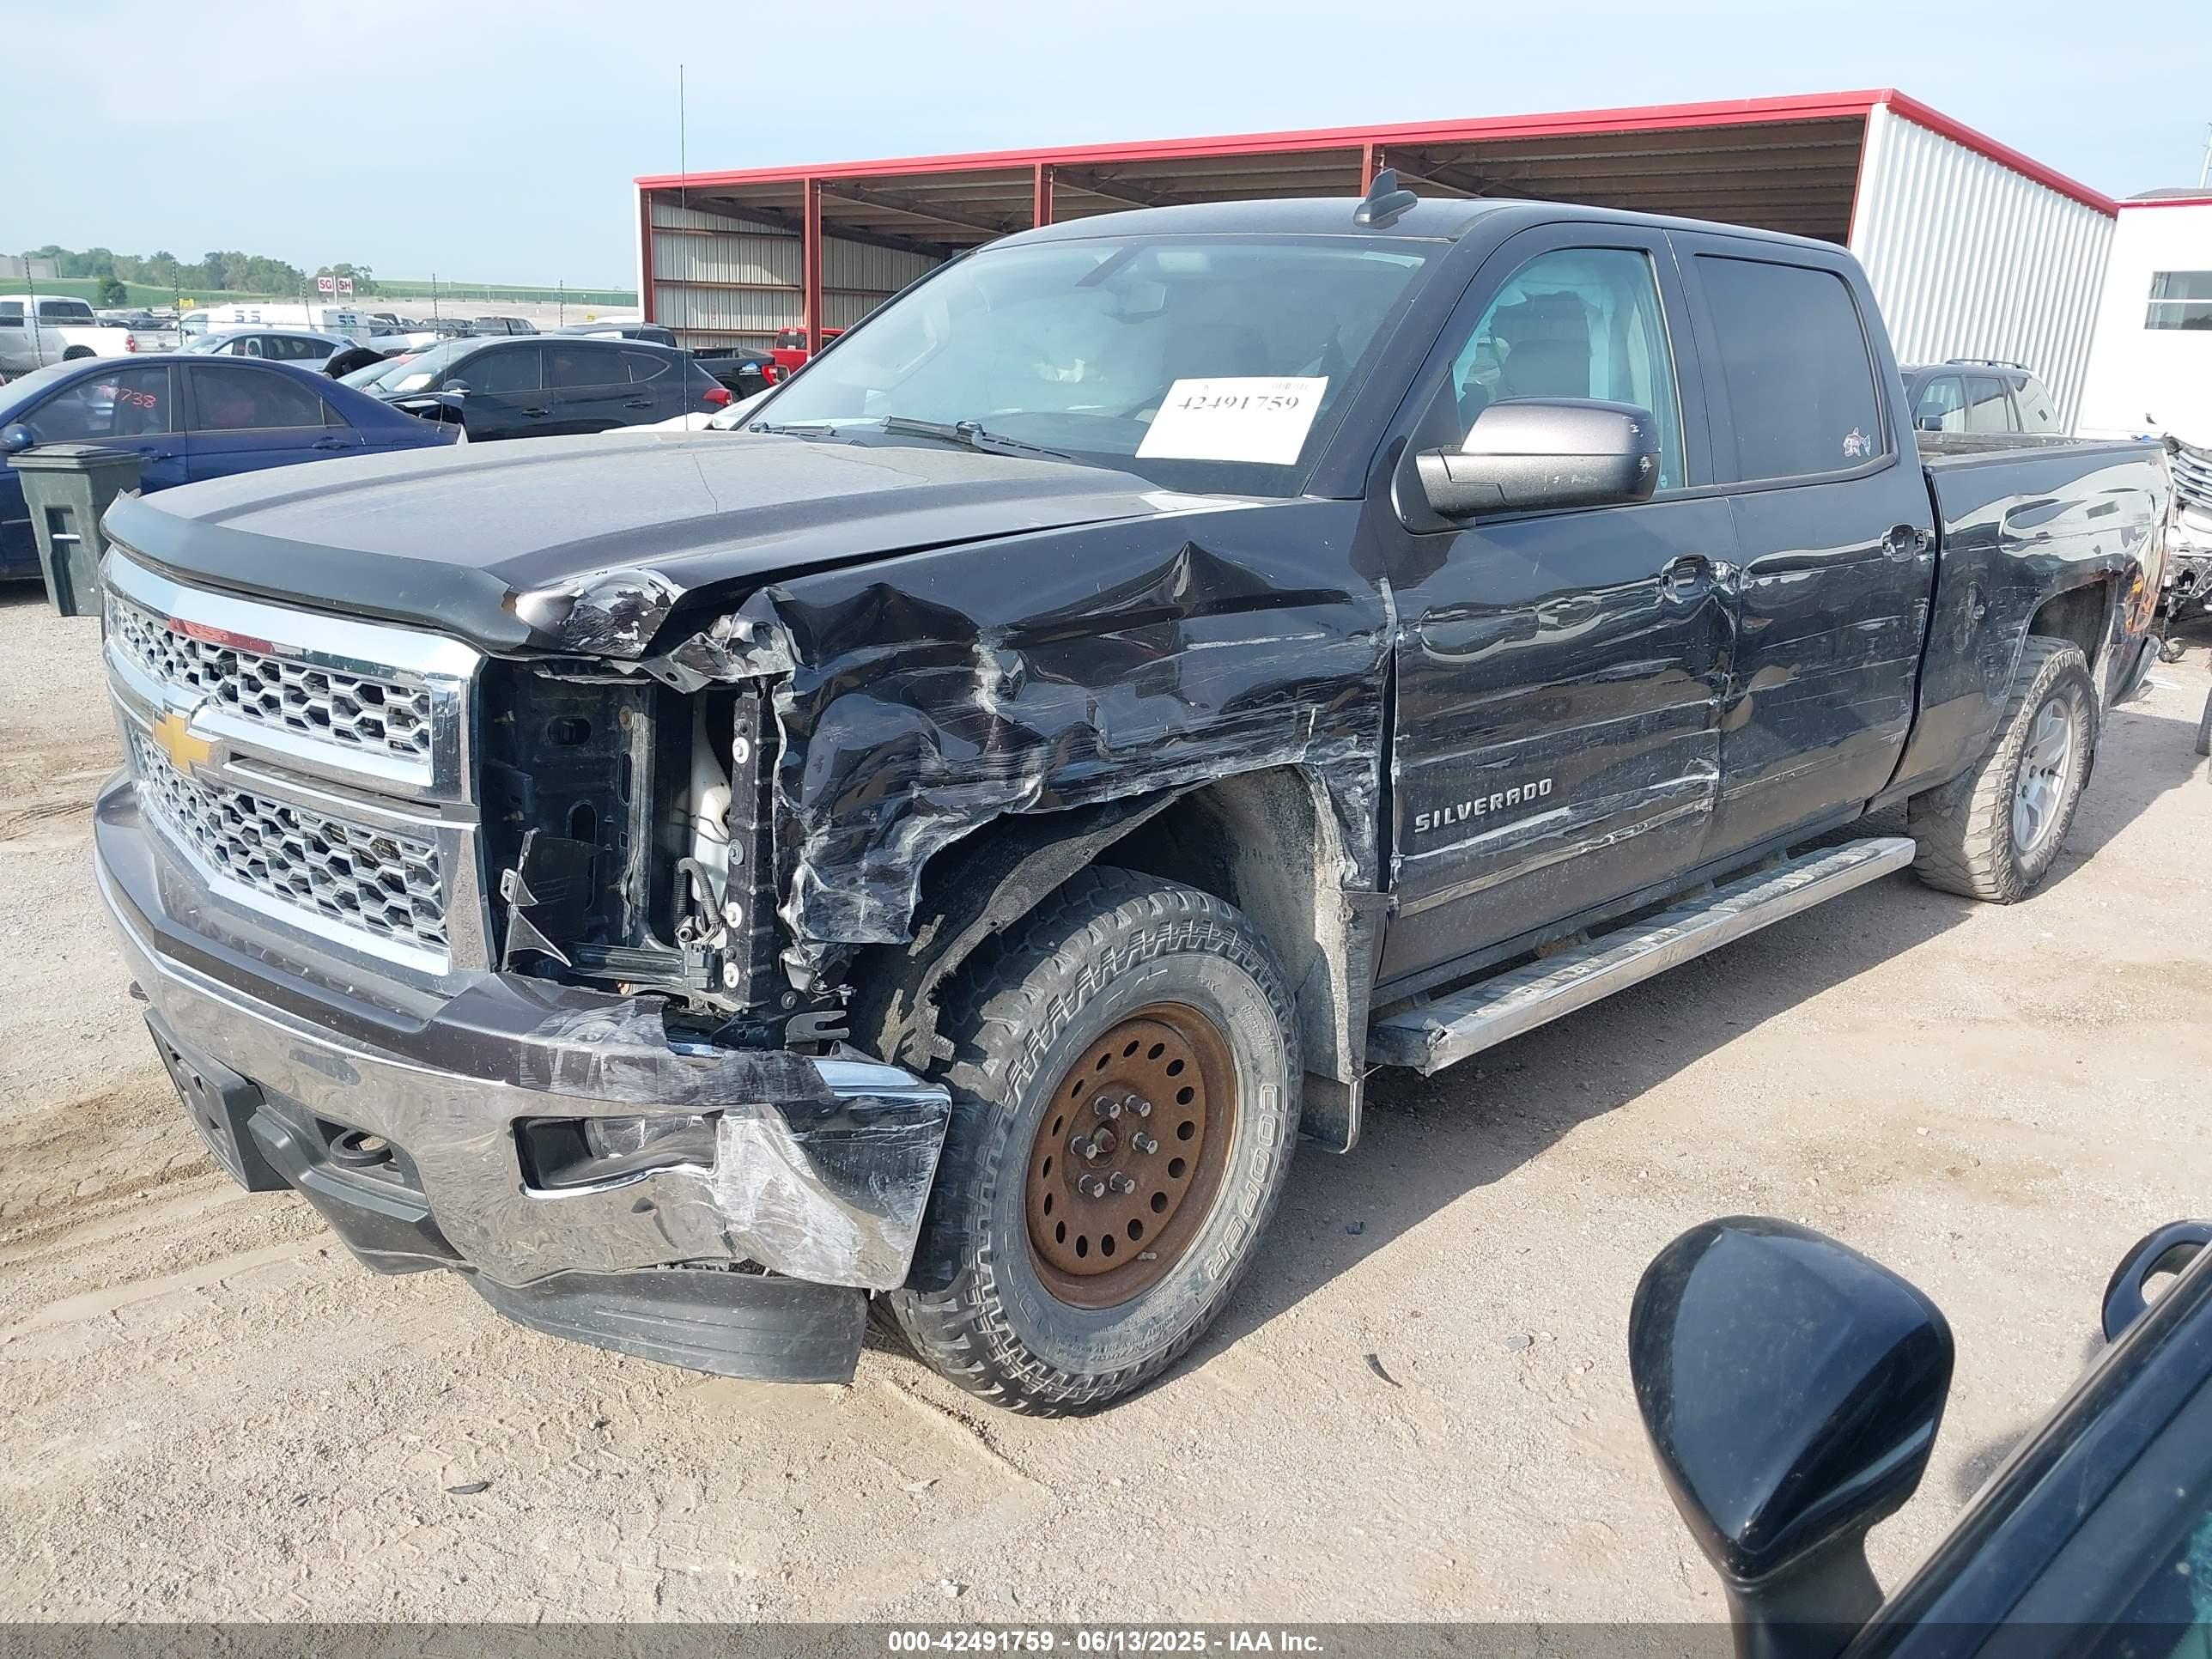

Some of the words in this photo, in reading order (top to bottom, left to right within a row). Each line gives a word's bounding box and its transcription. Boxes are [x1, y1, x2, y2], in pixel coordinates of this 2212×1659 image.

[319, 279, 332, 289] SG
[338, 280, 351, 290] SH
[1177, 395, 1300, 411] 42491759
[1413, 777, 1553, 834] SILVERADO
[1205, 1084, 1278, 1279] COOPER
